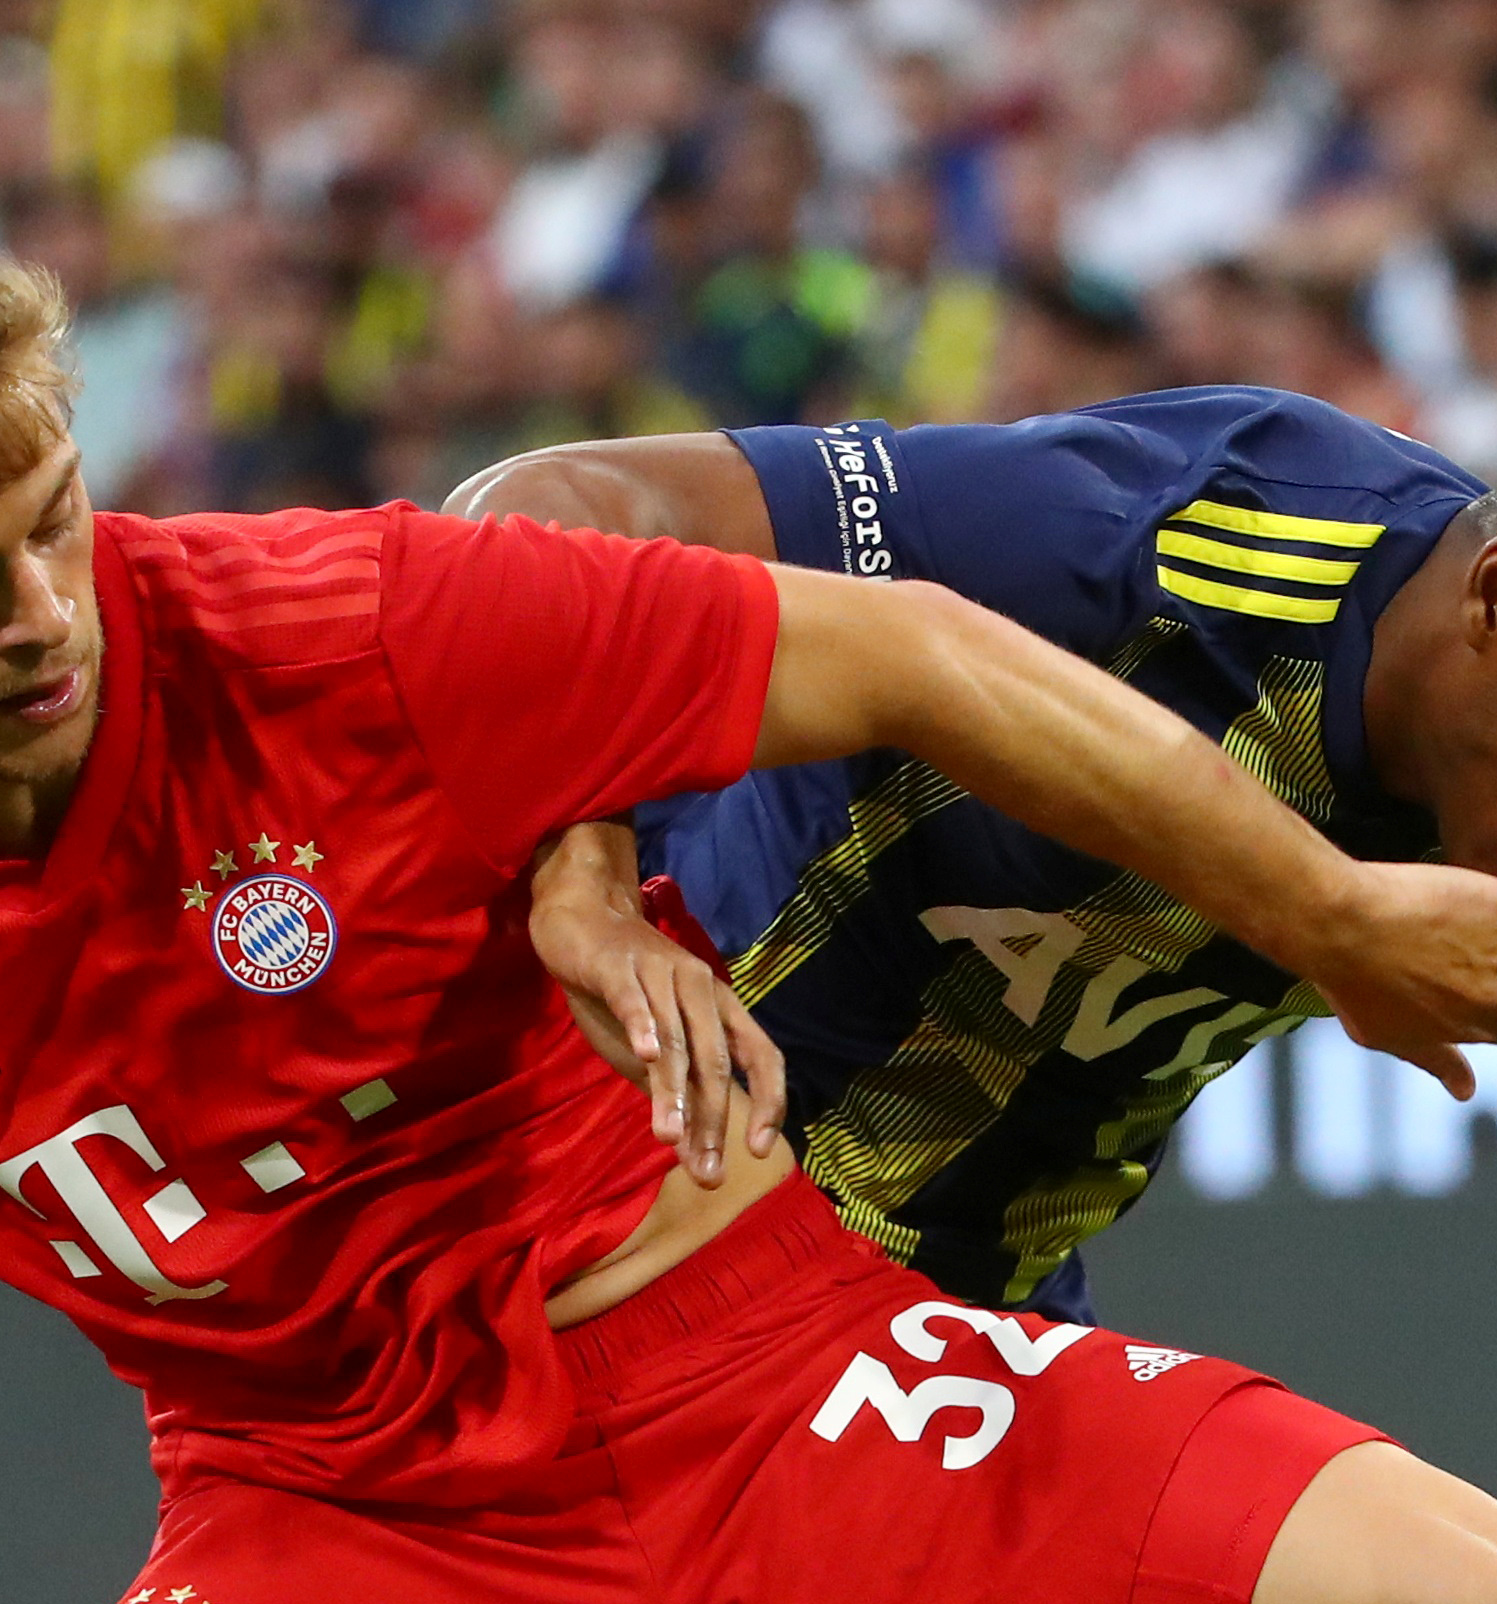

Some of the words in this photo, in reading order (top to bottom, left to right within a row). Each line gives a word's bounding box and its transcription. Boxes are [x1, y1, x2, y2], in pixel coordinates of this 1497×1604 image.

[828, 439, 893, 583] HeForS
[220, 913, 239, 942] FC
[231, 883, 316, 915] BAYERN
[233, 932, 328, 988] MÜNCHEN
[808, 1300, 1096, 1471] 32
